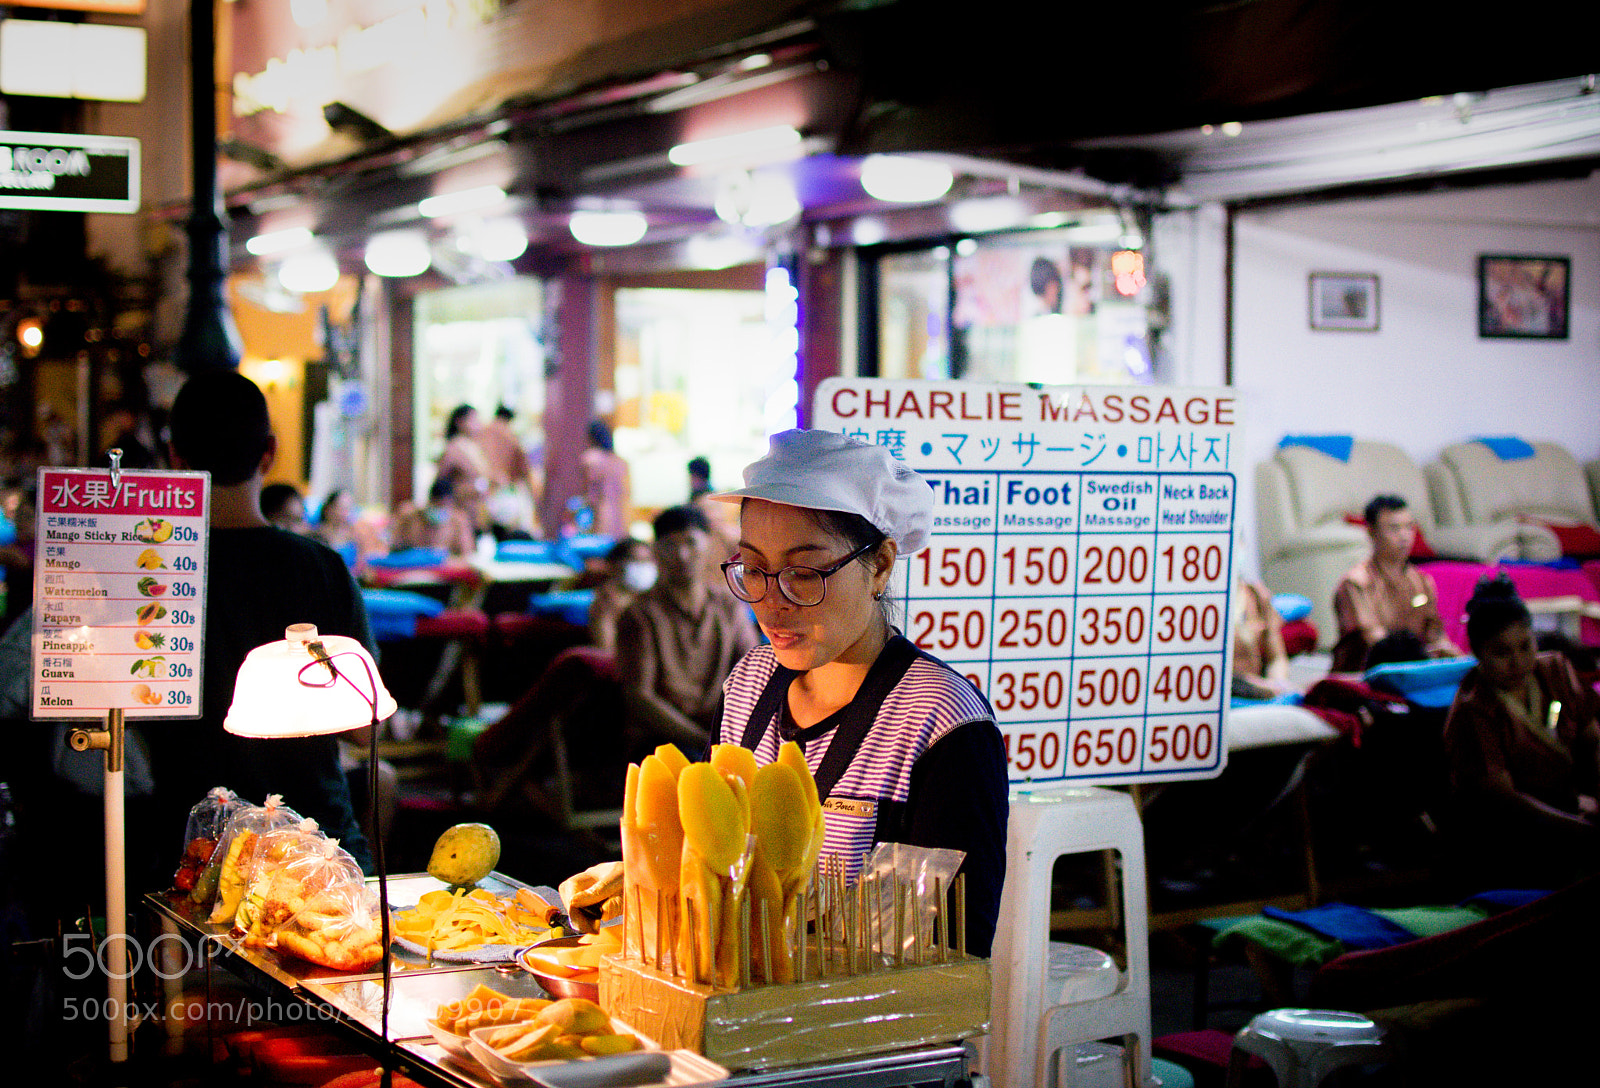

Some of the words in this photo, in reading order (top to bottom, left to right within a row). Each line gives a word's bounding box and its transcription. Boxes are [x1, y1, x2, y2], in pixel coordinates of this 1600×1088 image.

[831, 389, 1022, 421] CHARLIE
[1040, 393, 1235, 426] MASSAGE
[1007, 481, 1072, 506] Foot
[1087, 480, 1153, 495] Swedish
[1164, 485, 1195, 500] Neck
[1199, 484, 1229, 500] Back
[1102, 497, 1137, 511] Oil
[933, 516, 991, 529] assage
[1003, 514, 1072, 529] Massage
[1085, 514, 1150, 529] Massage
[1163, 510, 1186, 525] Head
[1189, 509, 1229, 525] Shoulder
[46, 530, 80, 541] Mango
[84, 531, 117, 543] Sticky
[45, 558, 81, 570] Mango
[917, 547, 987, 587] 150
[1003, 547, 1068, 585] 150
[1083, 546, 1148, 584] 200
[1162, 545, 1222, 582] 180
[44, 586, 108, 597] Watermelon
[43, 612, 81, 624] Papaya
[914, 610, 986, 650] 250
[999, 608, 1067, 648] 250
[1080, 606, 1144, 645] 350
[1157, 605, 1219, 643] 300
[42, 640, 95, 653] Pineapple
[41, 668, 75, 678] Guava
[995, 671, 1063, 711] 350
[1077, 667, 1141, 707] 500
[1153, 664, 1216, 702] 400
[40, 697, 73, 706] Melon
[1073, 727, 1137, 768] 650
[1149, 723, 1212, 762] 500
